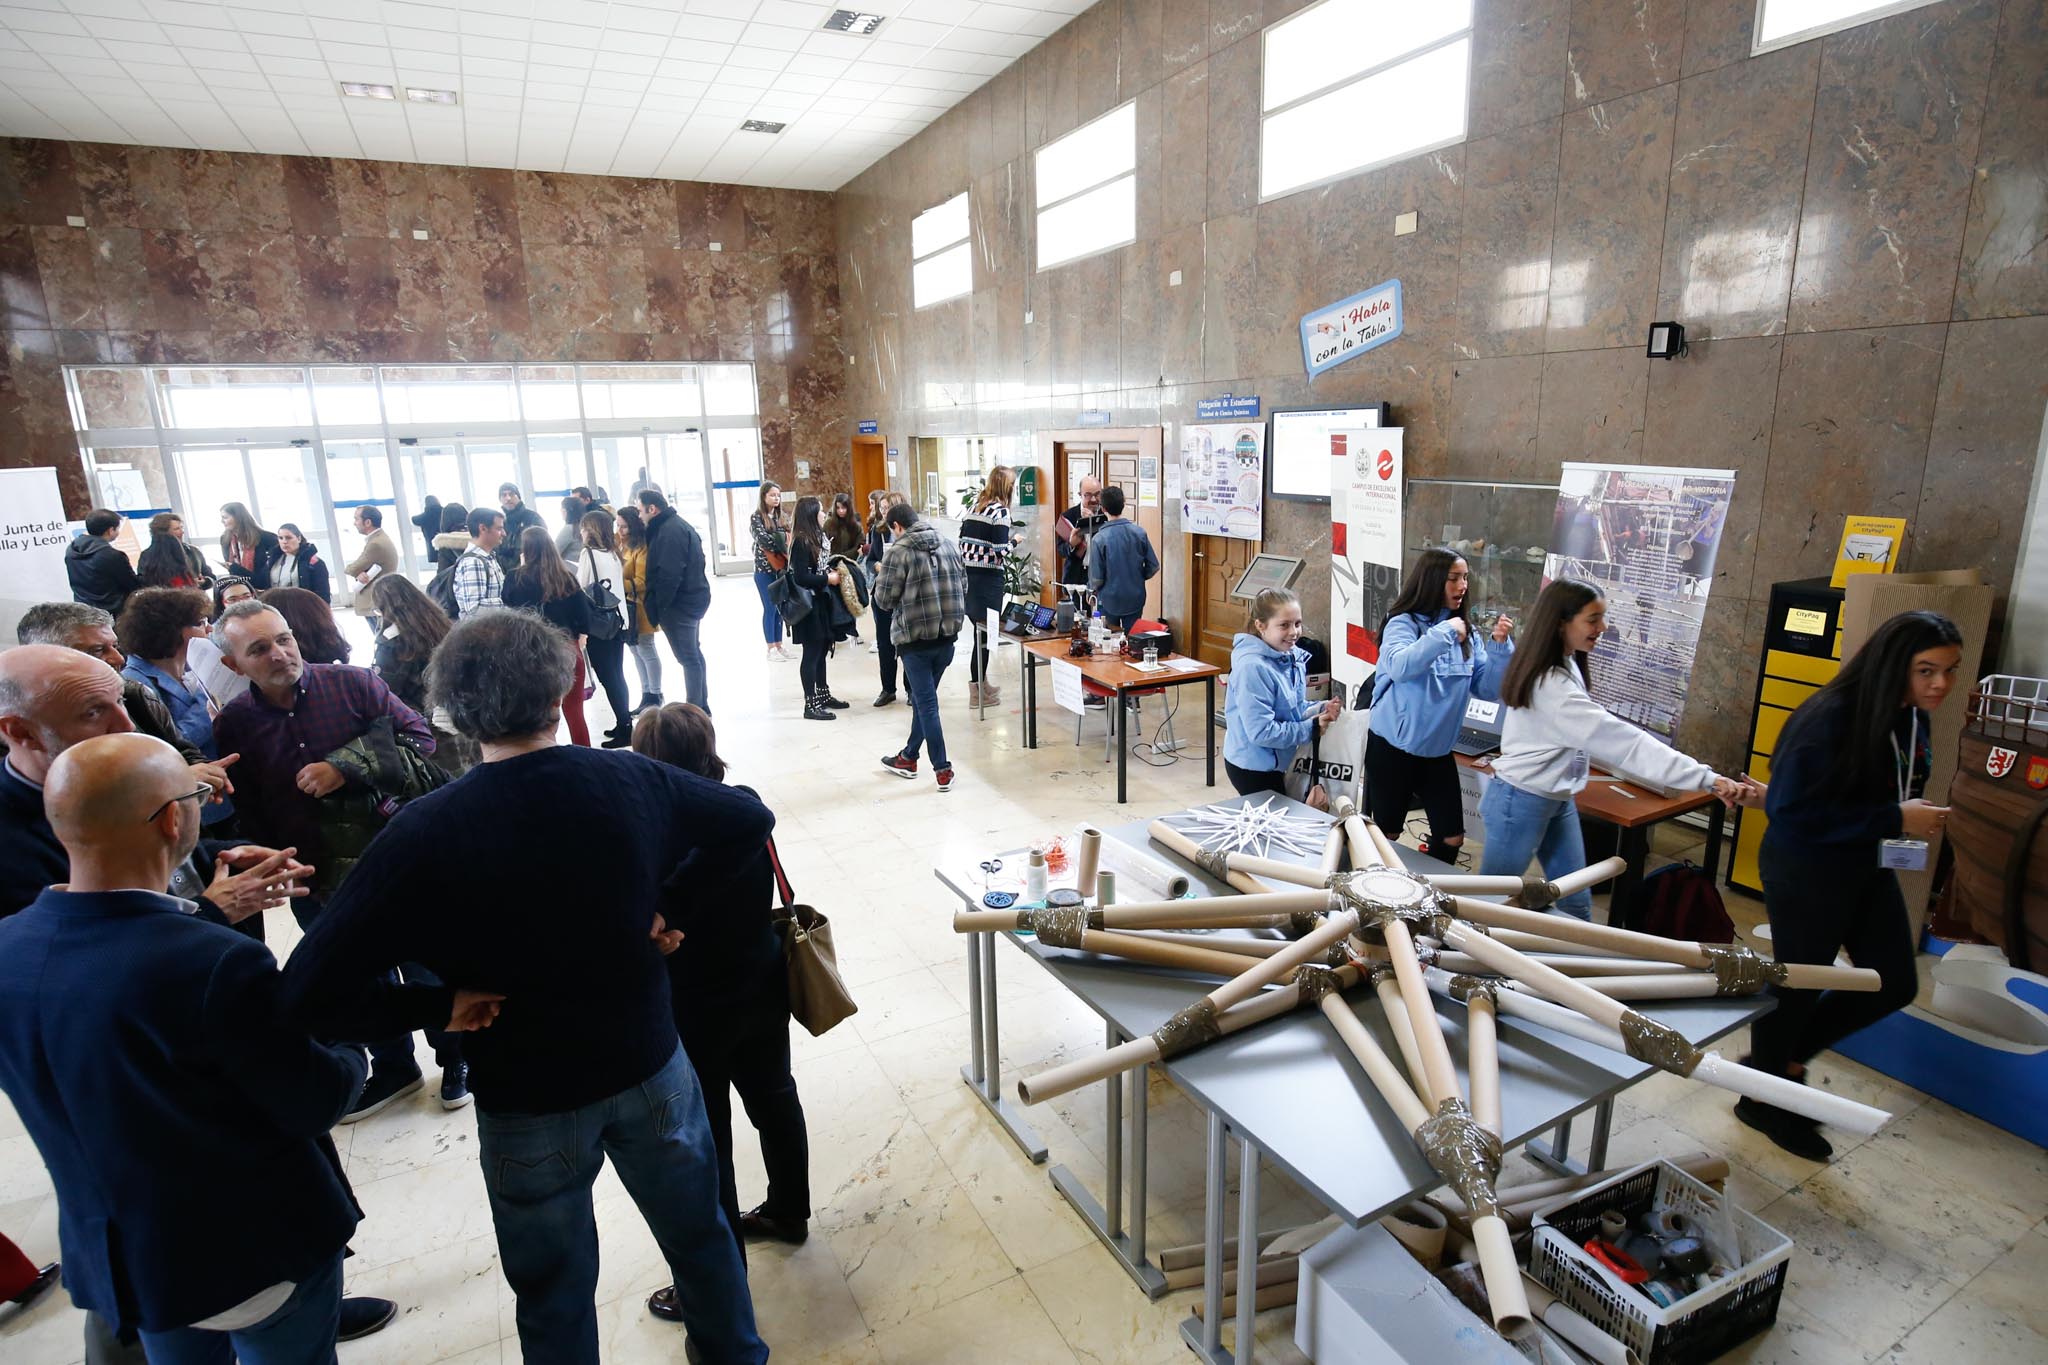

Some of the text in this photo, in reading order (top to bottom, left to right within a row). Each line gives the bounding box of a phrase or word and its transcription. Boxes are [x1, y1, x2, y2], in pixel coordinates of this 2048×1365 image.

[1316, 346, 1337, 363] con
[1342, 337, 1353, 351] la
[1223, 399, 1228, 407] de
[1695, 486, 1727, 495] VICTORIA
[4, 521, 63, 536] Junta de
[0, 534, 66, 552] lla y León
